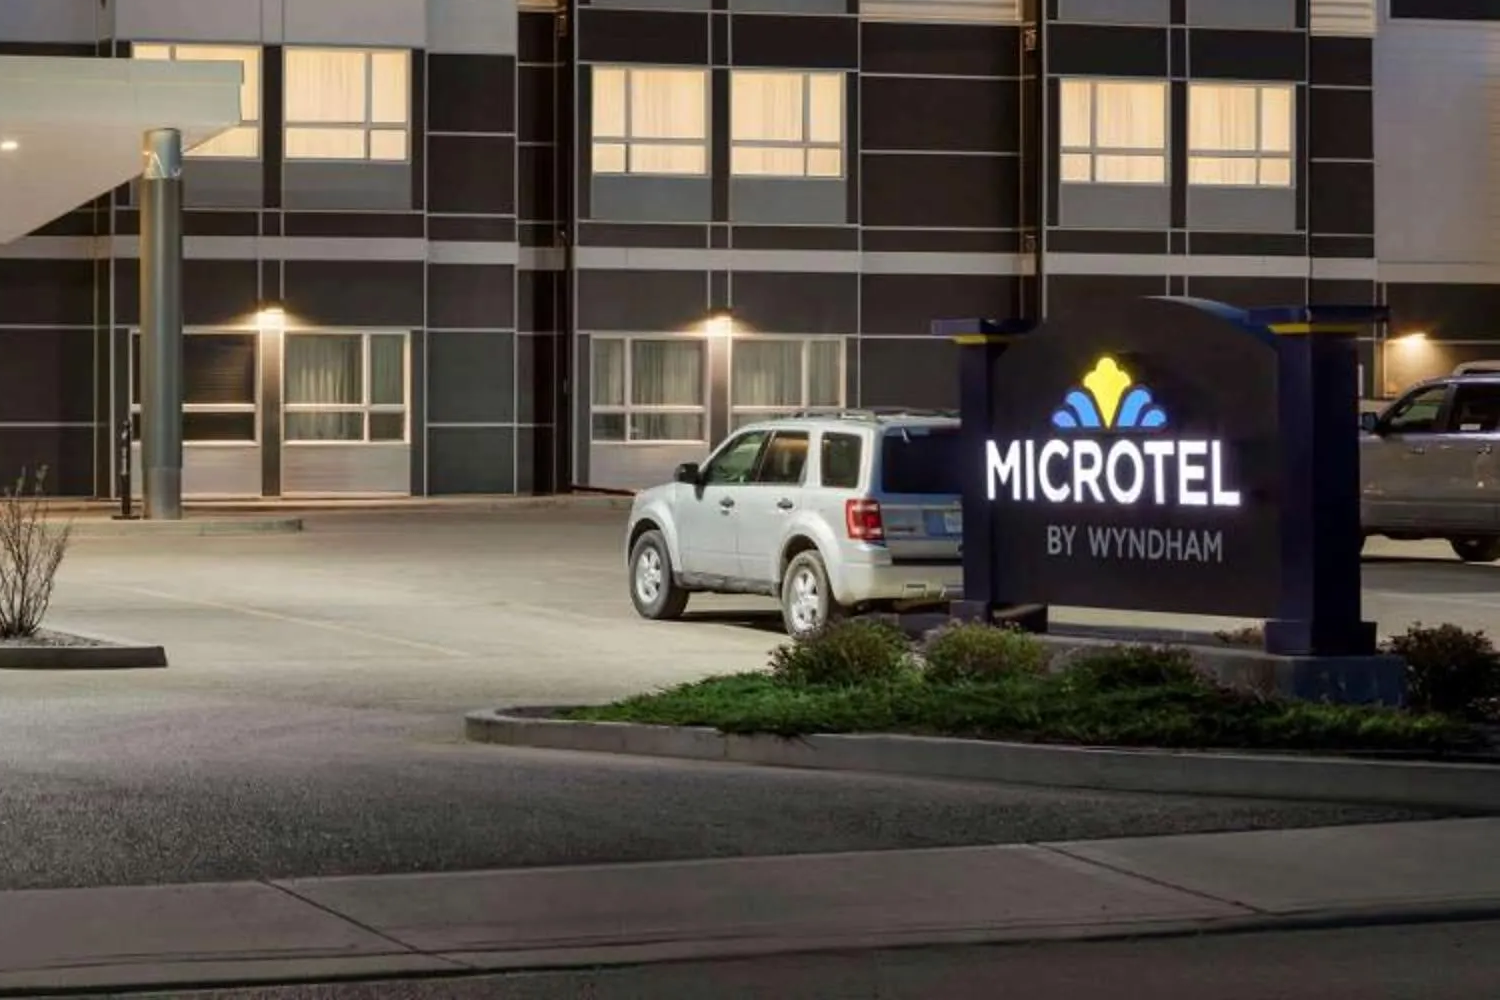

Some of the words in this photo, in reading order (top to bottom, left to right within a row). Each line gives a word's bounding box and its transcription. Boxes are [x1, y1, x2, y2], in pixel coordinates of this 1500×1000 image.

[985, 438, 1241, 506] MICROTEL
[1046, 525, 1077, 556] BY
[1088, 527, 1223, 562] WYNDHAM
